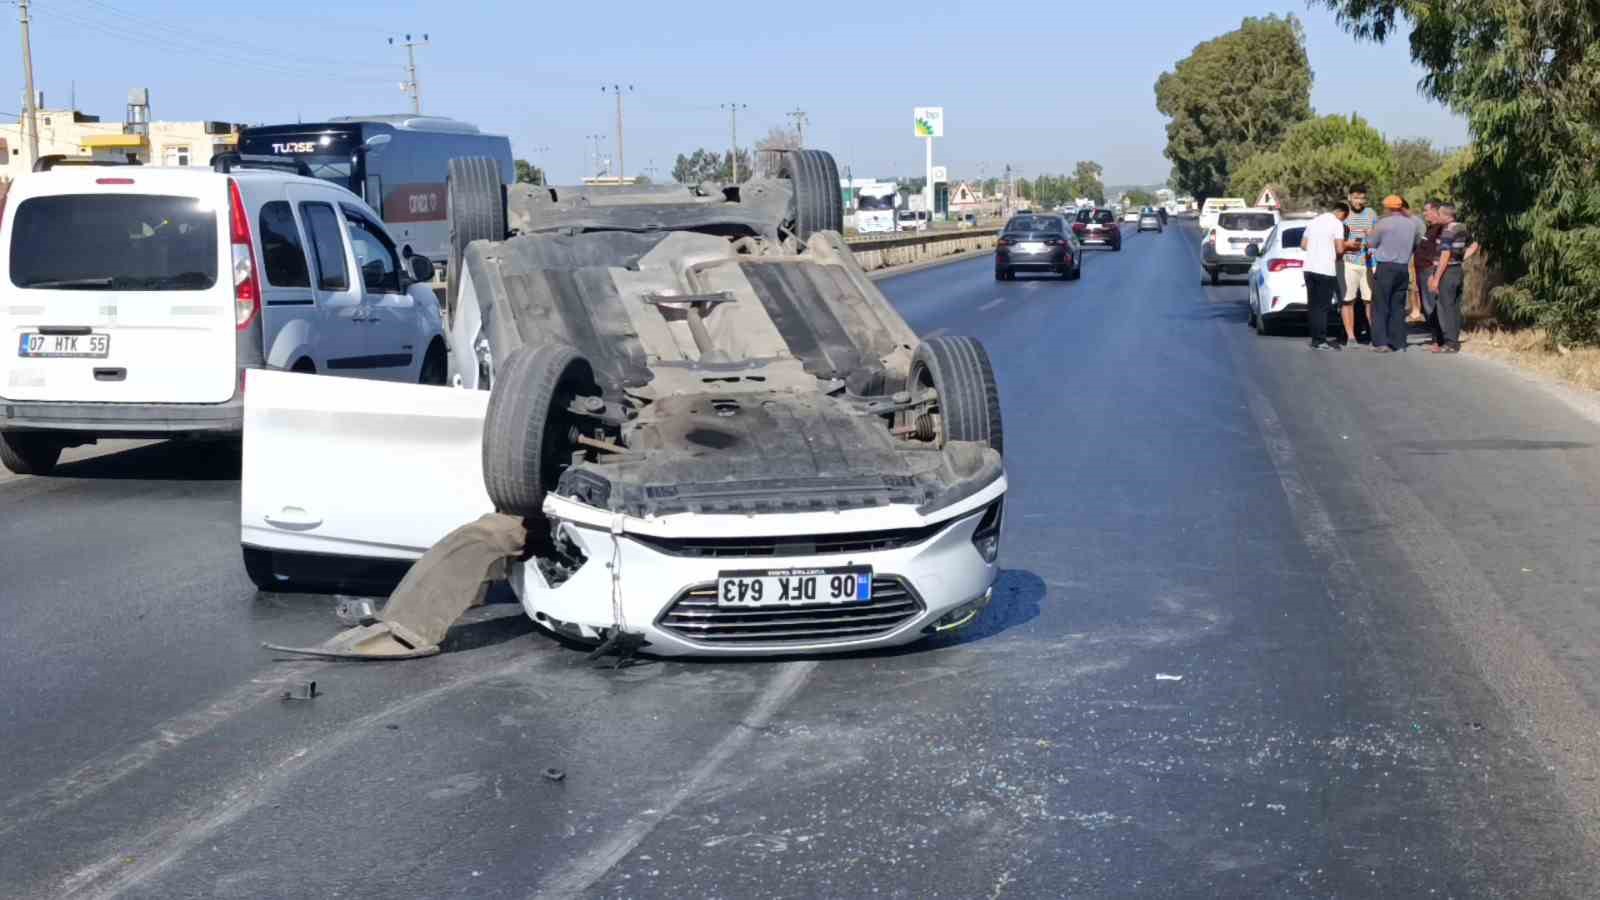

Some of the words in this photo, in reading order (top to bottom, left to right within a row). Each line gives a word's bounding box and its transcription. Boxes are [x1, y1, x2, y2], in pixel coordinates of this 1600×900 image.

[271, 142, 315, 154] TURSE
[30, 336, 45, 351] 07
[55, 336, 78, 352] HTK
[89, 336, 105, 352] 55
[723, 579, 763, 602] 643
[779, 577, 817, 601] DFK
[830, 575, 855, 598] 06
